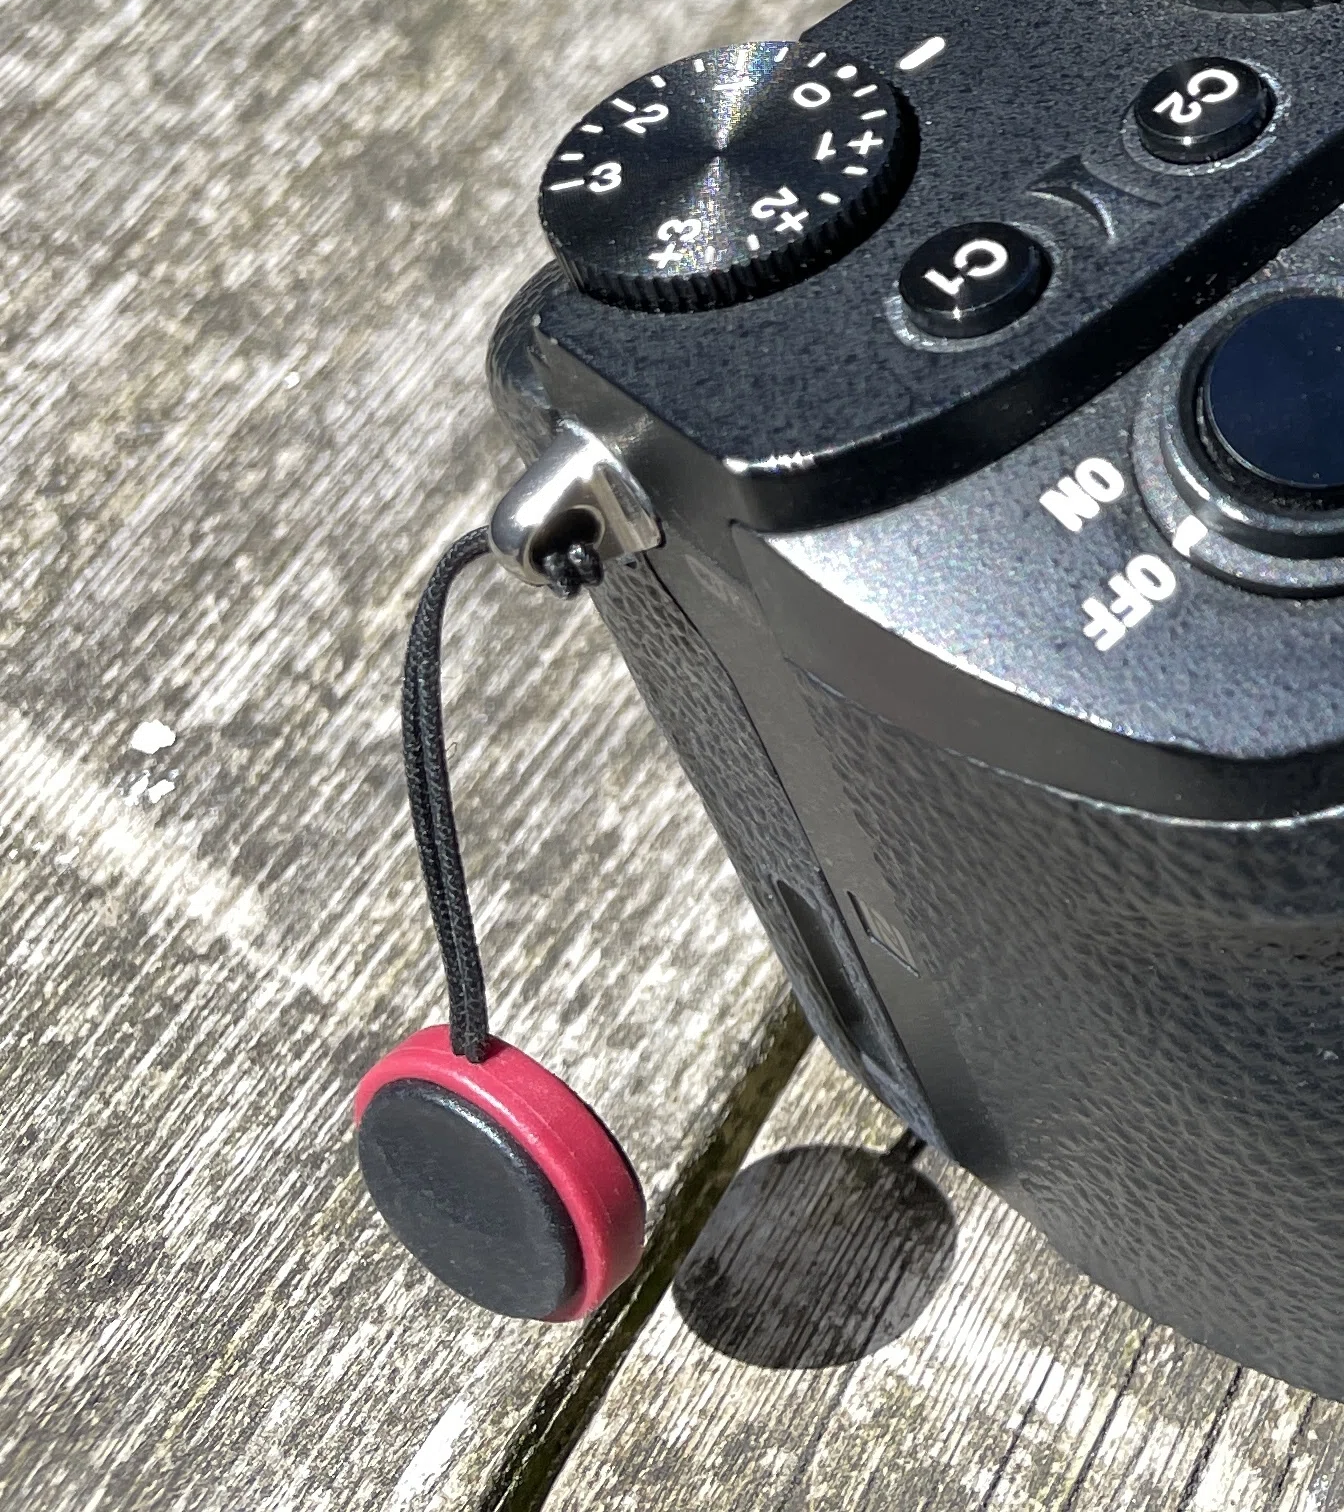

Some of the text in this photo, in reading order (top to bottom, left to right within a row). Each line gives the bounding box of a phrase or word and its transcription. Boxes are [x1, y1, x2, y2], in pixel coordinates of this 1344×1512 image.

[792, 82, 831, 108] 0
[1153, 68, 1239, 124] C2
[924, 239, 1008, 296] C1
[1039, 457, 1125, 532] ON
[1083, 554, 1176, 651] OFF
